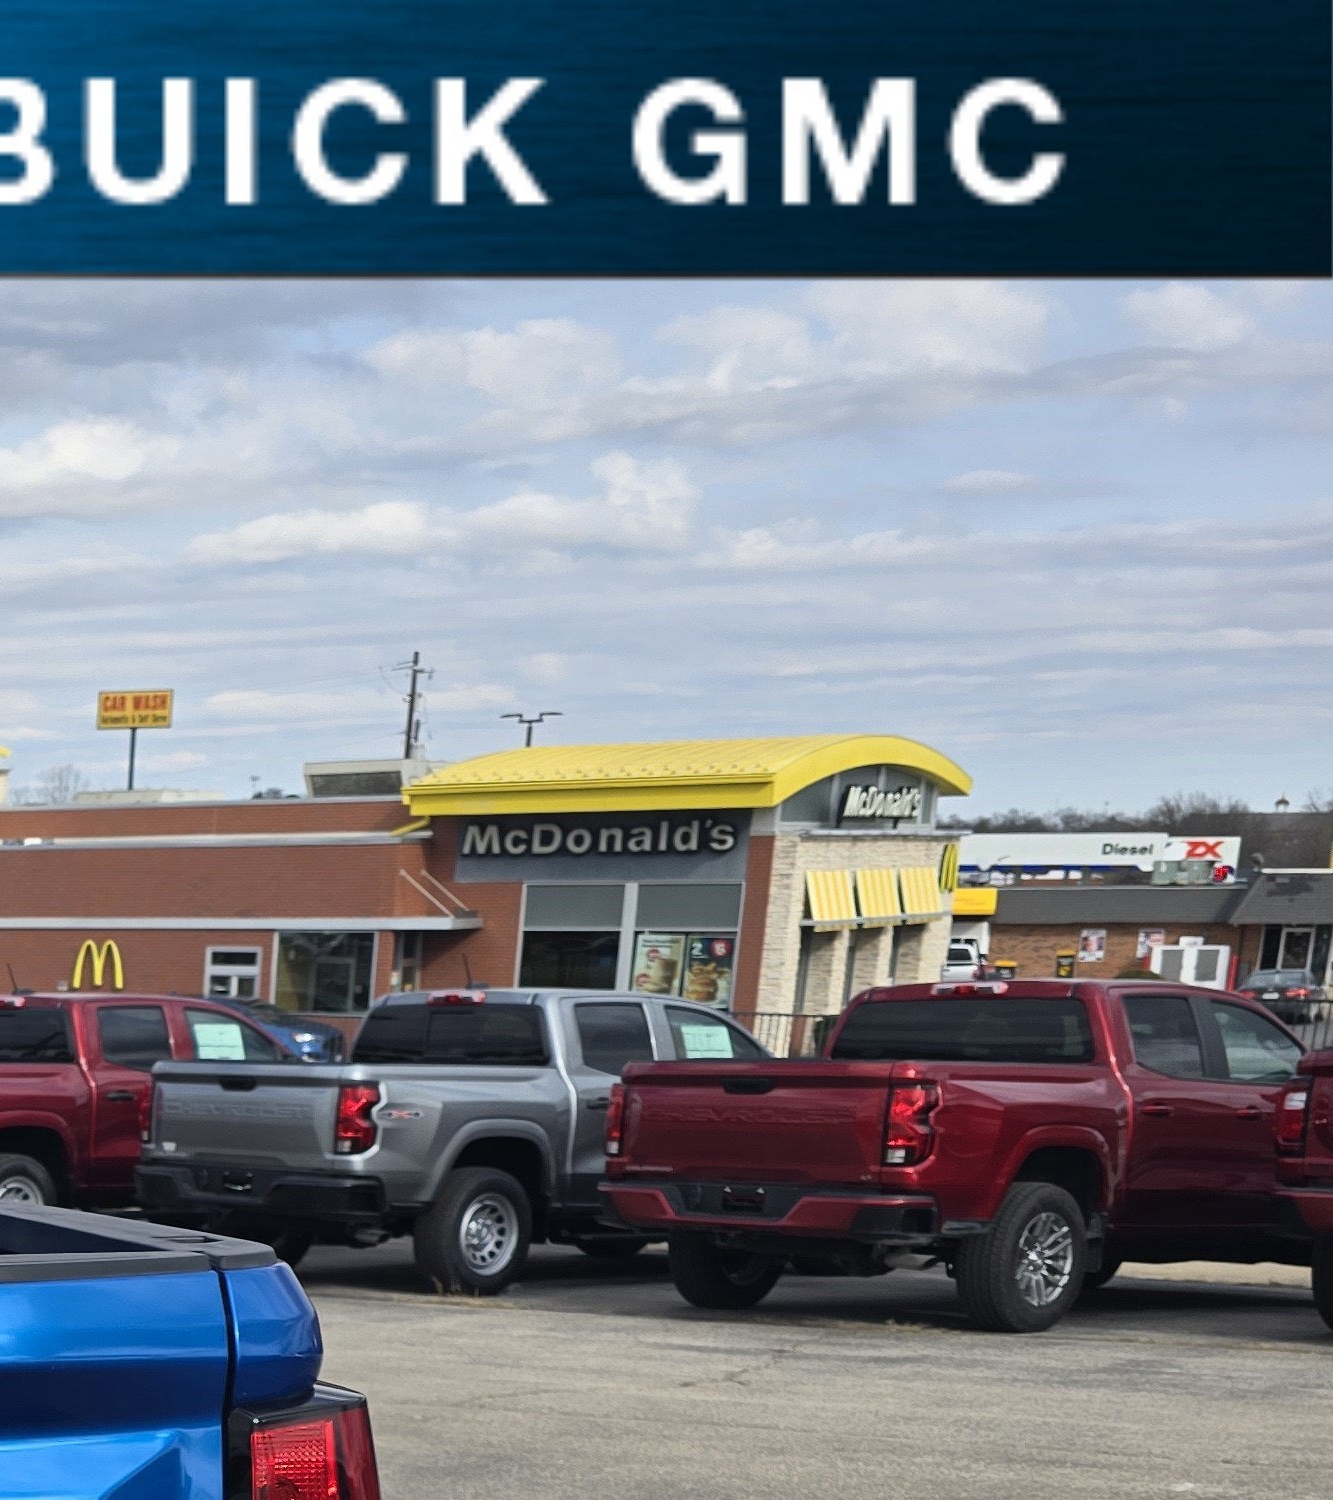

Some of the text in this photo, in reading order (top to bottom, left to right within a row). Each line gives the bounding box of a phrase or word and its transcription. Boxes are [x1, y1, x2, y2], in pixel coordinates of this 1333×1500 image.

[102, 694, 168, 712] CAR WASH
[461, 819, 736, 855] McDonald's
[1101, 842, 1155, 856] Diesel
